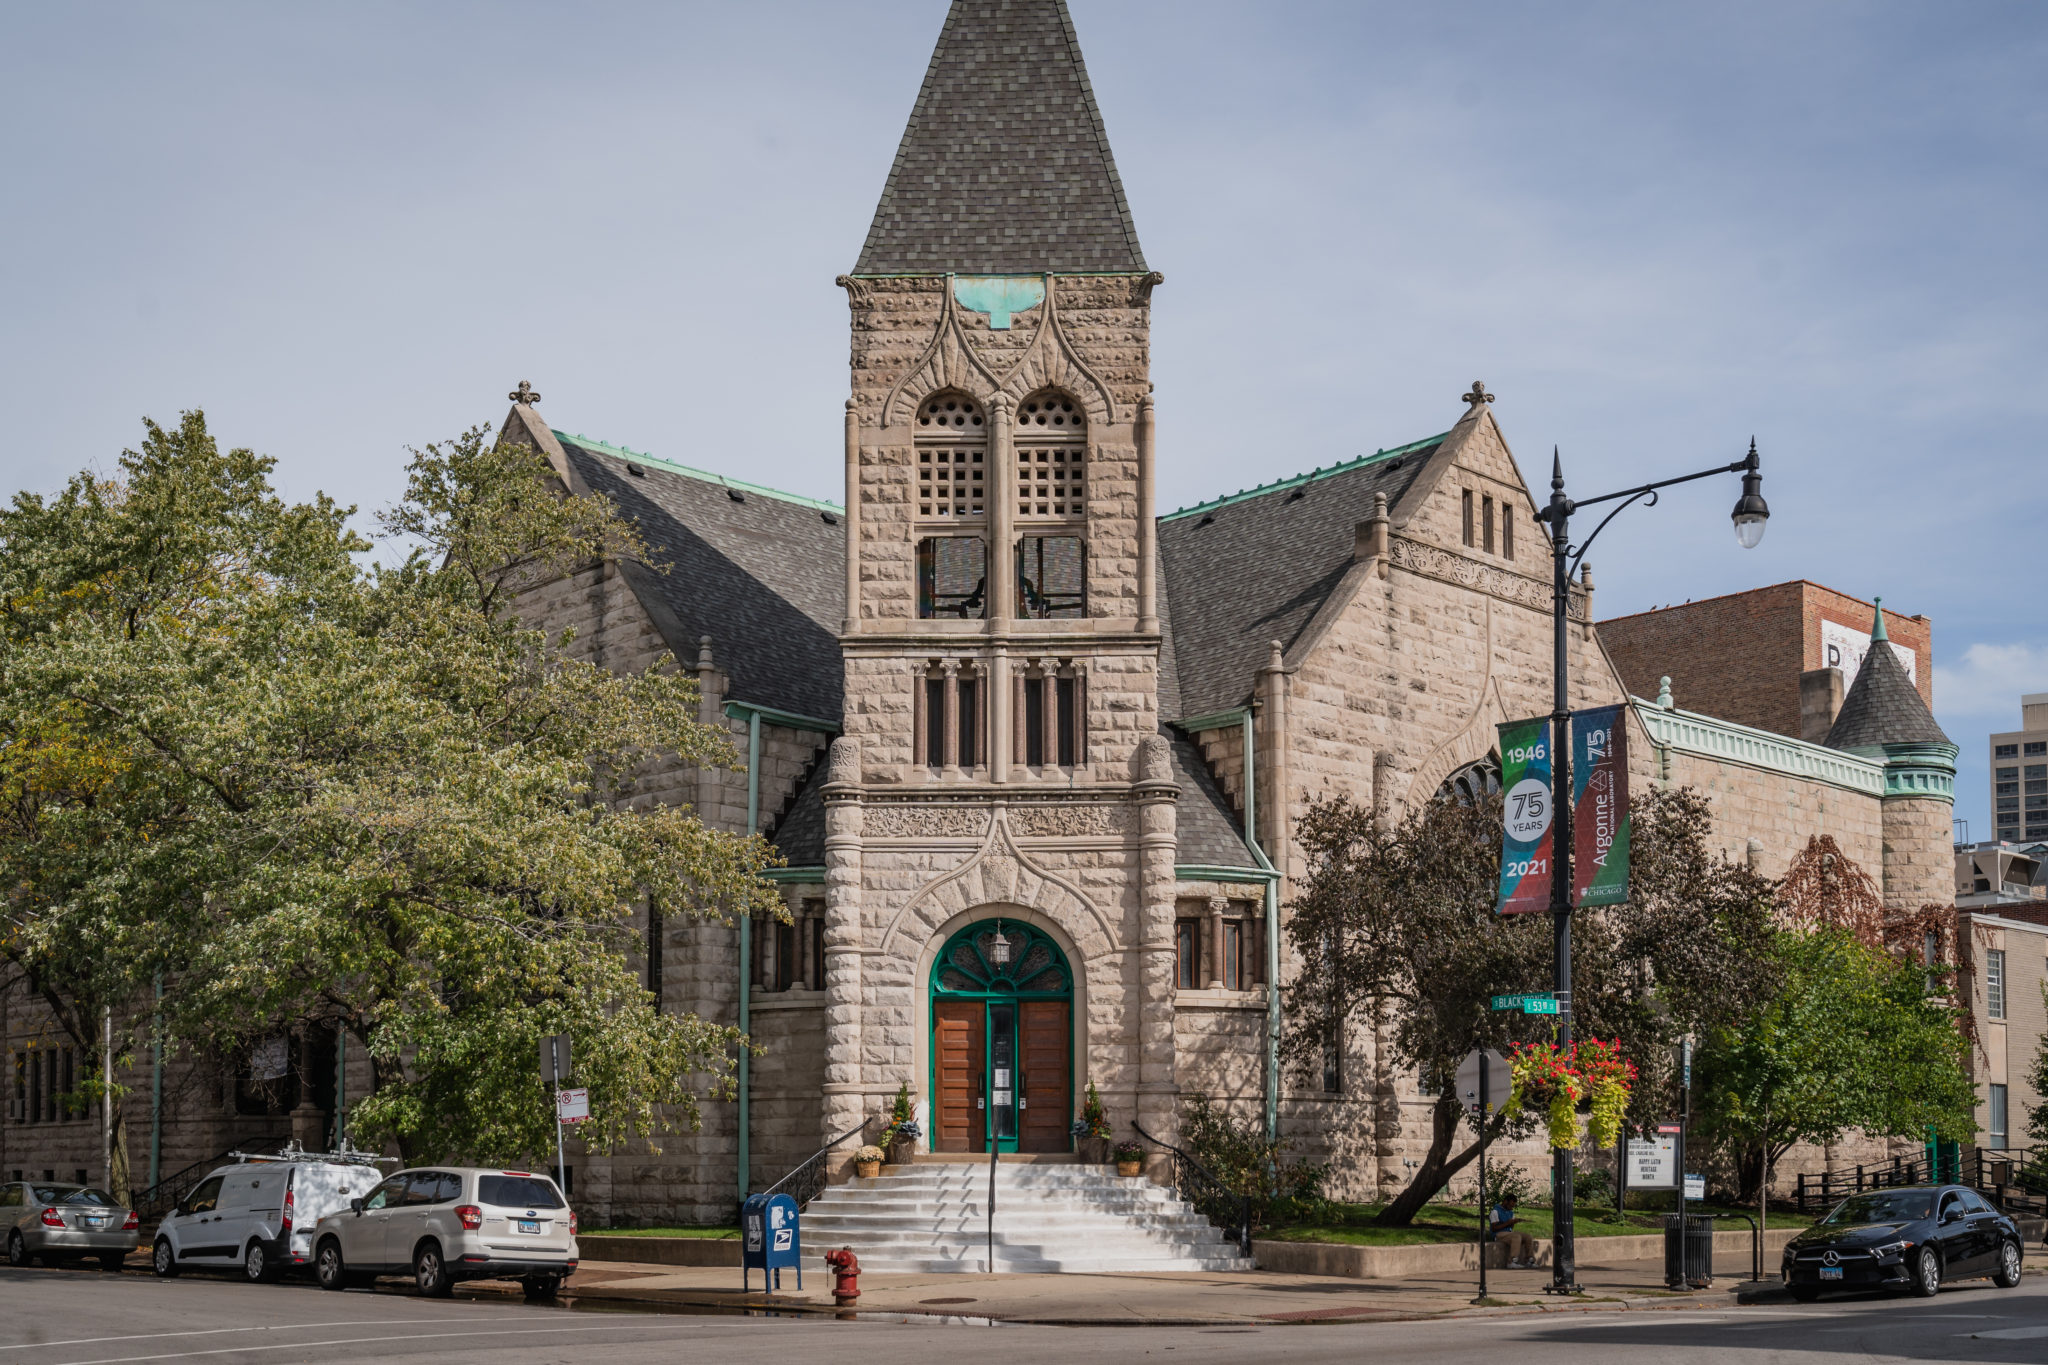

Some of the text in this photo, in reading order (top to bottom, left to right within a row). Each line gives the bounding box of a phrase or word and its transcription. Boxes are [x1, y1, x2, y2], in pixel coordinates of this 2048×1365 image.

[1507, 744, 1546, 764] 1946
[1587, 729, 1606, 762] 75
[1512, 791, 1544, 820] 75
[1512, 820, 1543, 833] YEARS
[1593, 794, 1613, 867] Argonne
[1506, 859, 1547, 877] 2021
[1588, 887, 1622, 897] CHICAGO
